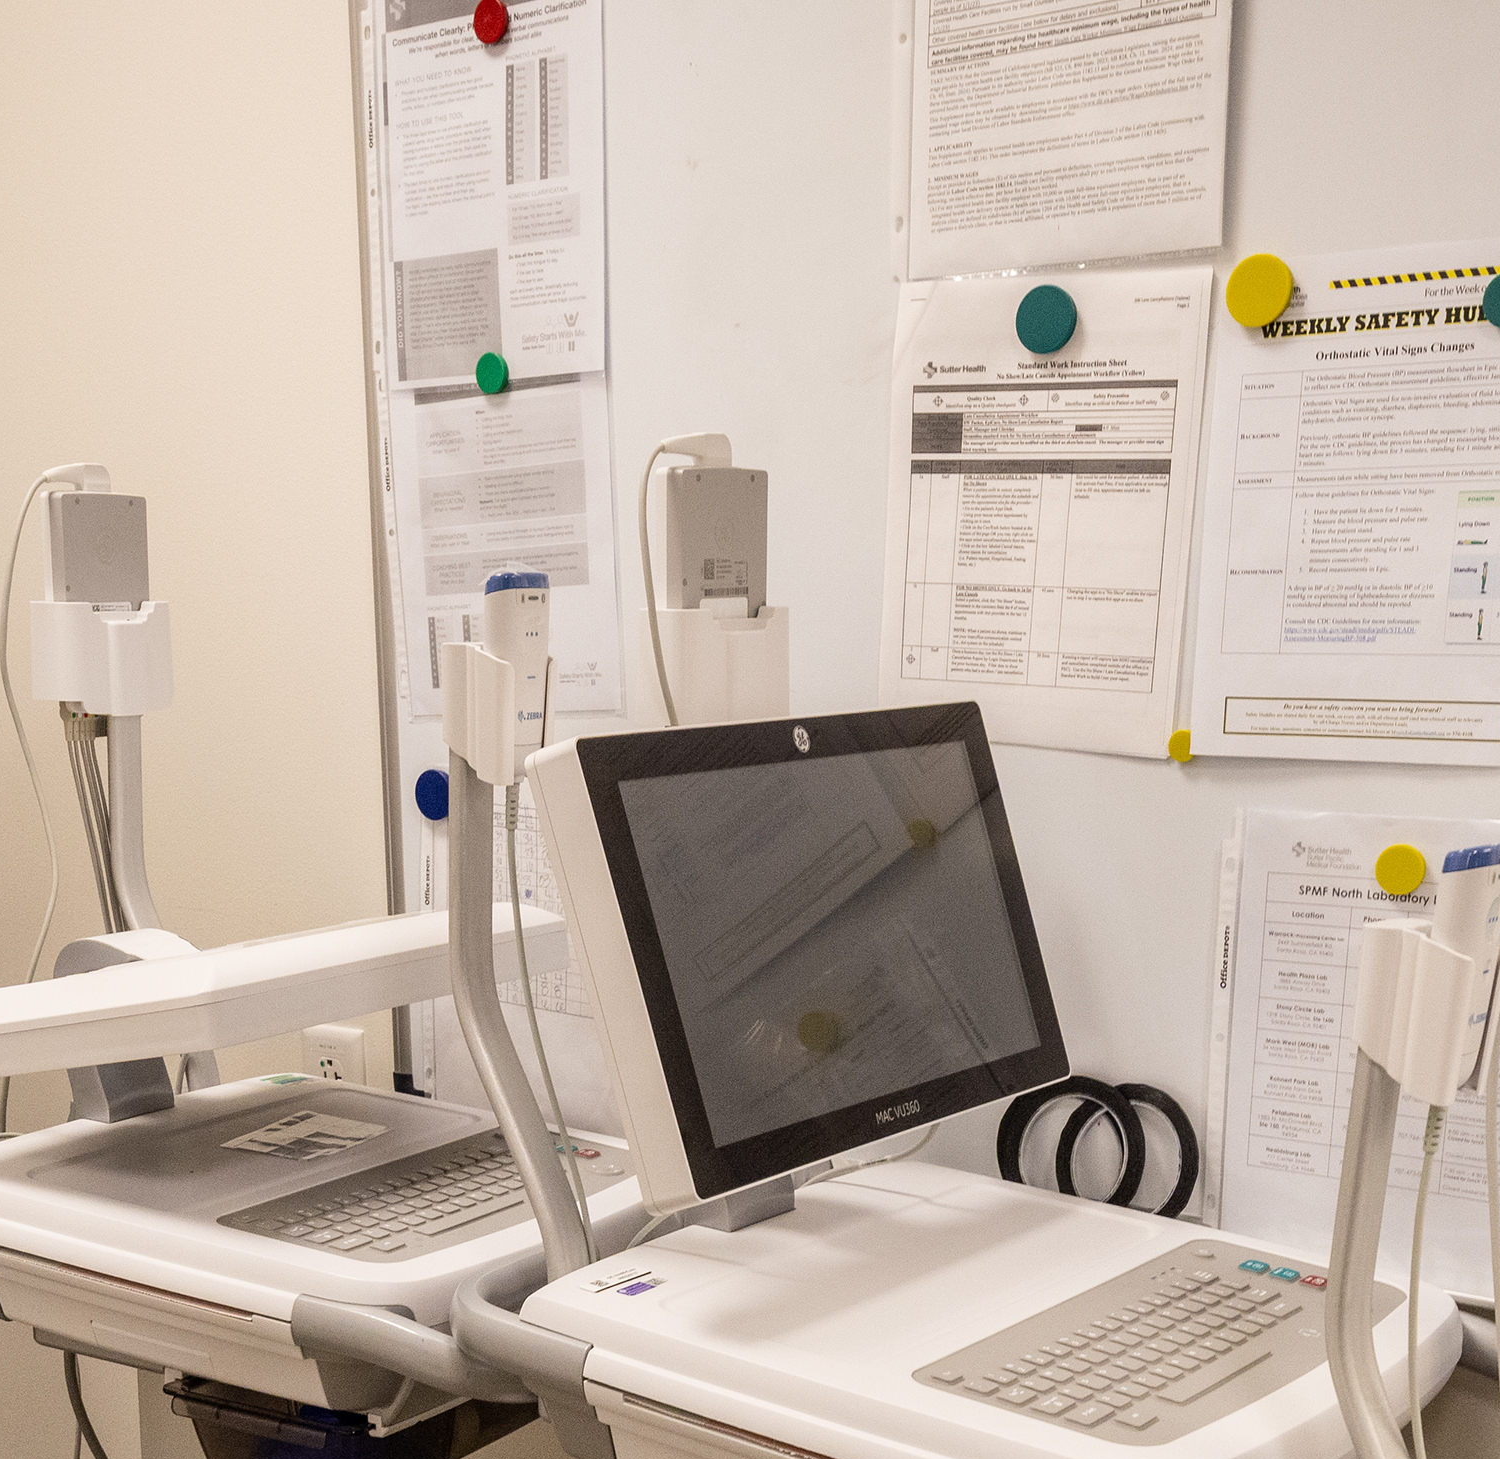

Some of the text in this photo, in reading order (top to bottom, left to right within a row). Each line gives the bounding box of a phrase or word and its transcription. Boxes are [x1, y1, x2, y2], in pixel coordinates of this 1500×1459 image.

[514, 0, 587, 20] Numeric Clarification
[392, 26, 465, 47] Communicate Clearly:
[1424, 287, 1440, 298] For
[1440, 286, 1454, 297] the
[1455, 285, 1480, 295] Week
[1261, 315, 1351, 339] WEEKLY
[1355, 308, 1439, 332] SAFETY
[1315, 341, 1475, 361] Orthostatic Vital Signs Changes
[939, 364, 986, 374] Sutter Health
[1017, 359, 1127, 370] Standard Work Instruction Sheet
[1057, 371, 1092, 379] Appointment
[526, 711, 543, 721] ZEBRA
[1298, 885, 1430, 907] SPMF North Laboratory
[1292, 911, 1325, 920] Location
[1220, 960, 1228, 989] Office
[876, 1100, 920, 1124] MAC VU360
